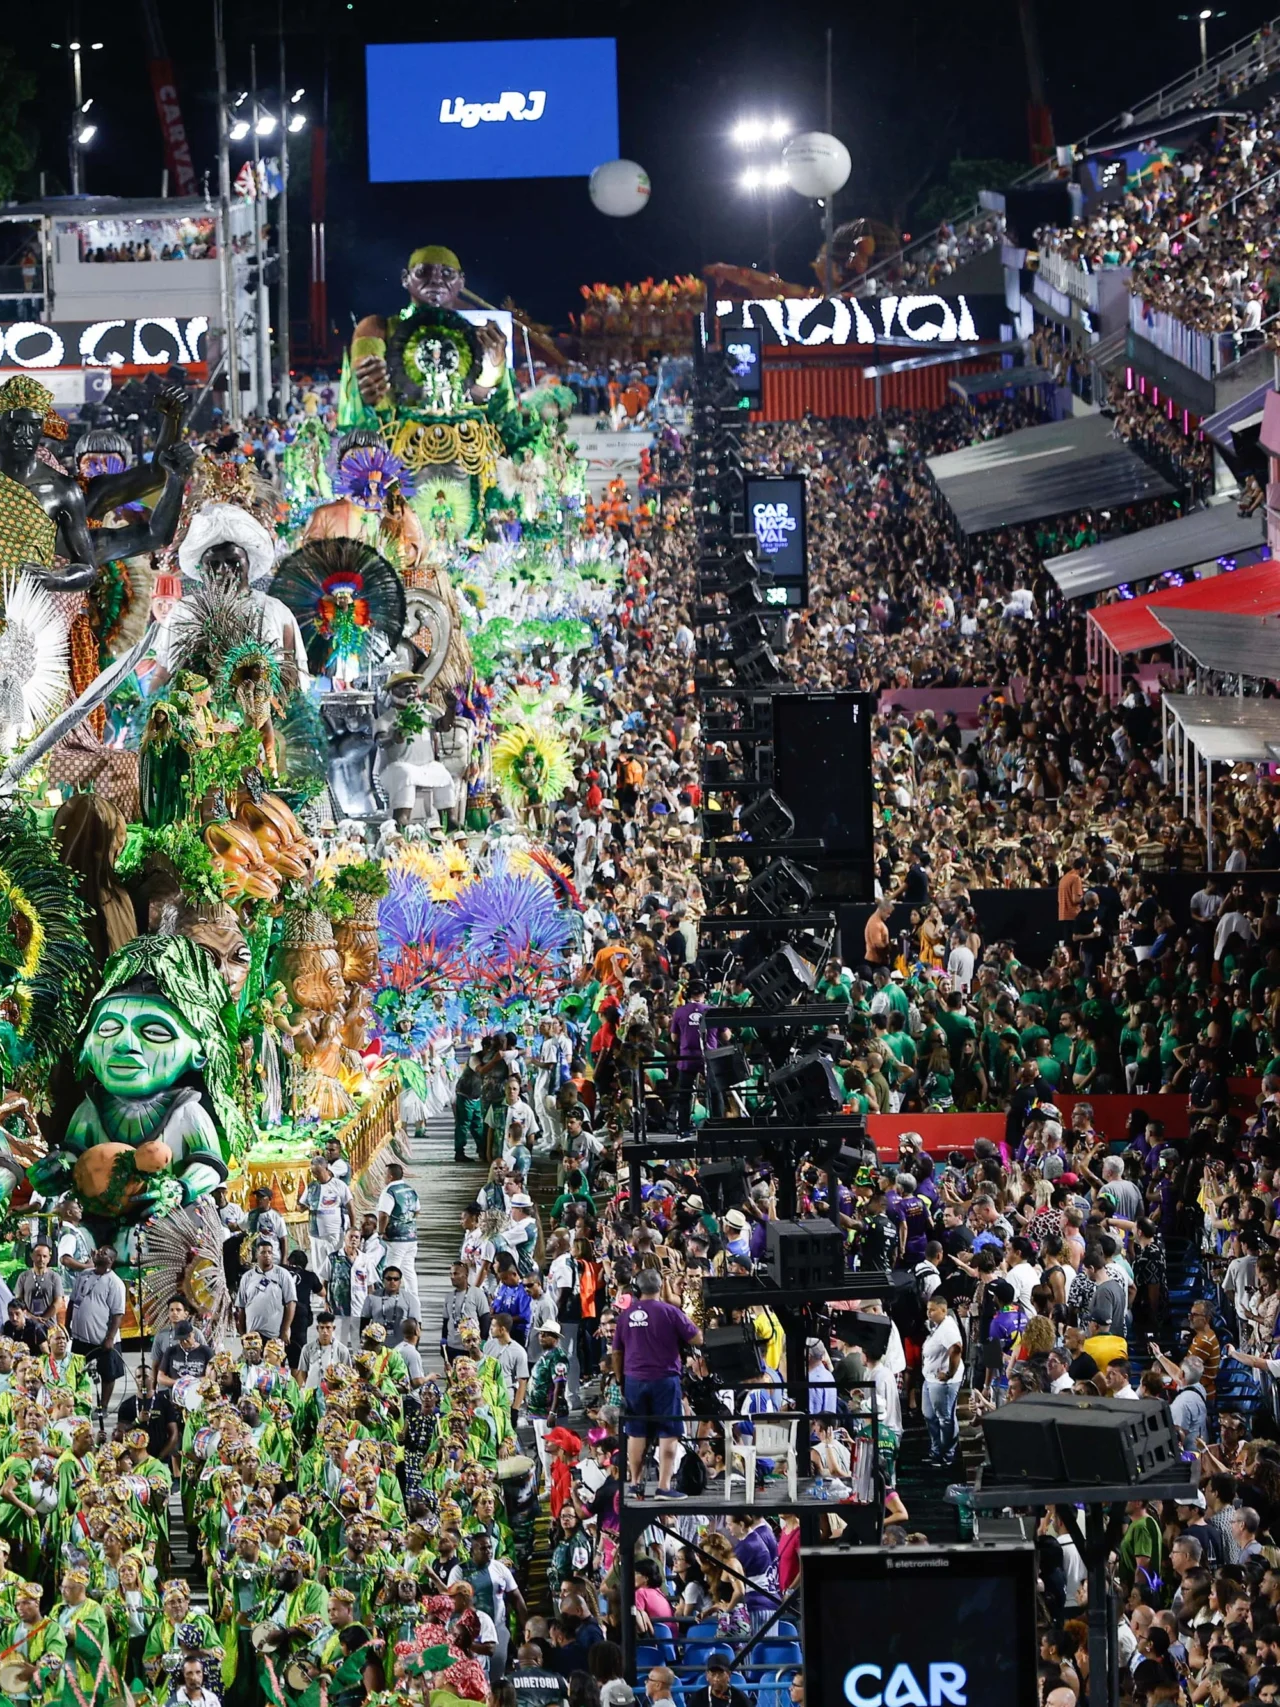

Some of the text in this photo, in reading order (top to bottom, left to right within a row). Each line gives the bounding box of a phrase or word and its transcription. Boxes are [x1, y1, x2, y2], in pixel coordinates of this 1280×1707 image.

[438, 90, 546, 128] LigaRJ
[753, 503, 789, 517] CAR
[757, 530, 788, 543] VAL
[895, 1558, 949, 1568] eletromidia
[513, 1677, 560, 1690] DIRETORIA
[844, 1662, 967, 1707] CAR
